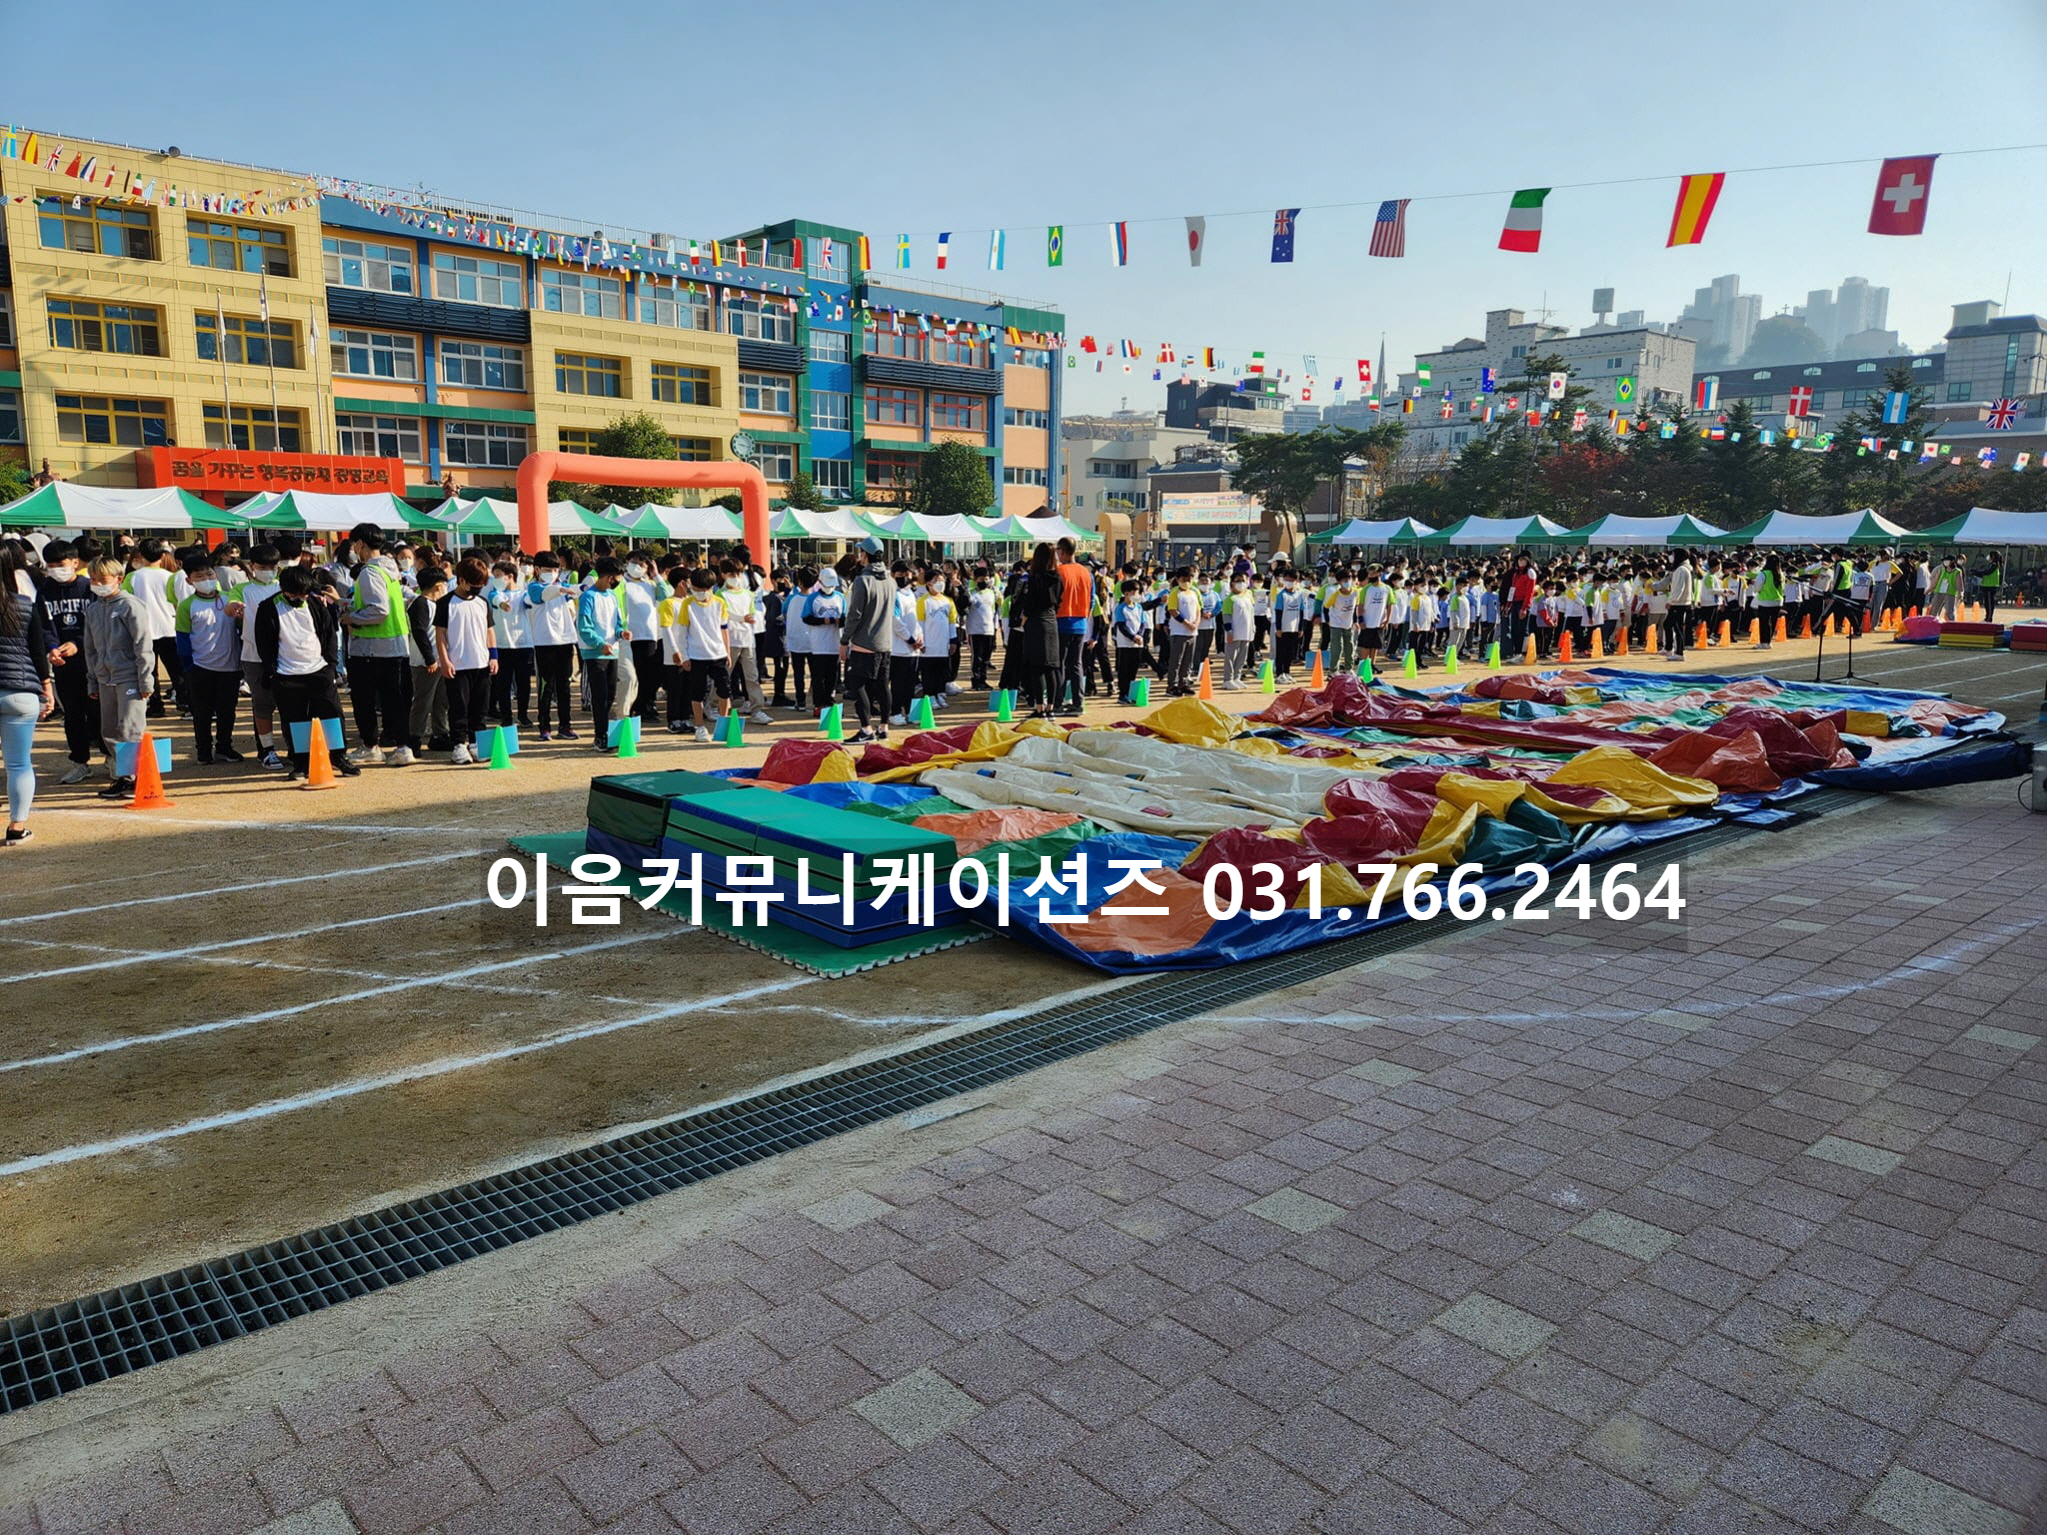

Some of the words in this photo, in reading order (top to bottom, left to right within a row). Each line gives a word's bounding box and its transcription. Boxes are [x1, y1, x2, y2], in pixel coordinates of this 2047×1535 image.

[172, 461, 205, 477] 꿈을
[208, 462, 254, 479] 가꾸는
[258, 464, 331, 482] 행복공동체
[334, 467, 389, 484] 광명교육
